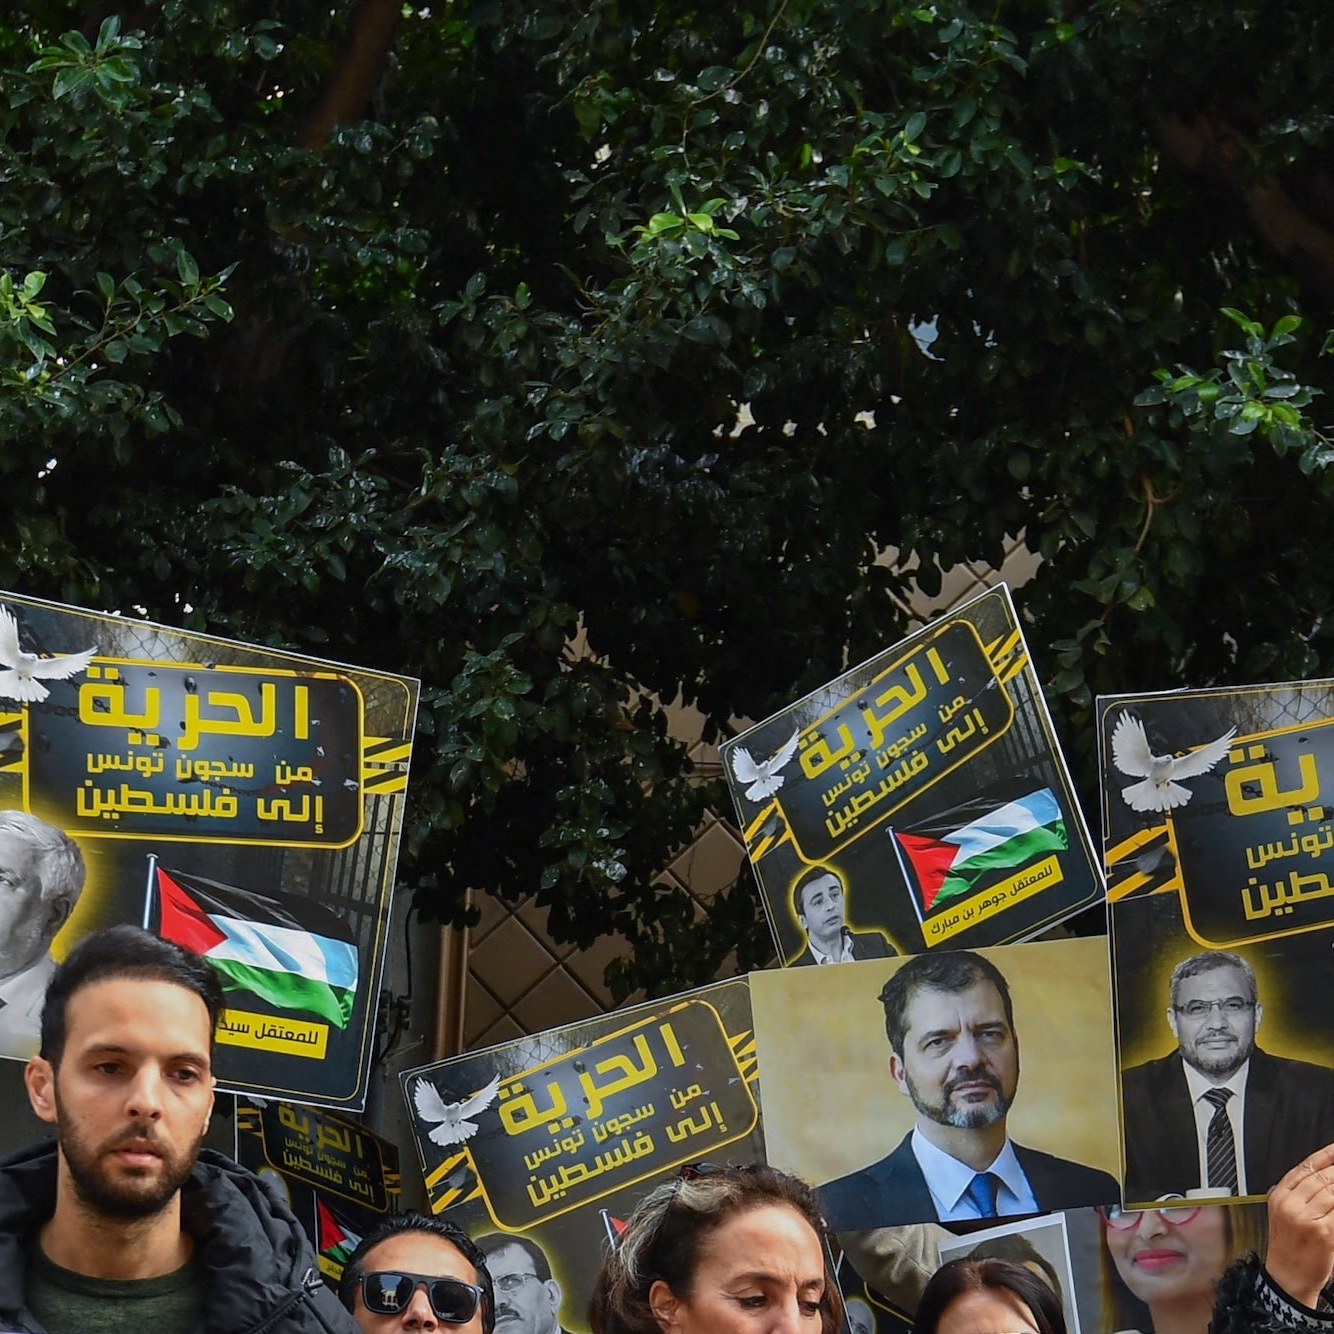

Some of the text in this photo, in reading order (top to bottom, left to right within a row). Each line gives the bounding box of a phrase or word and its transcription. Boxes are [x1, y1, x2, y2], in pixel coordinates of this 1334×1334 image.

[78, 666, 310, 751] الحرية
[798, 646, 950, 780] الحرية
[86, 750, 314, 786] من سجون تونس
[821, 694, 968, 807] من سجون تونس
[824, 708, 988, 839] إلى فلسطين
[76, 779, 324, 835] إلى فلسطين
[1245, 824, 1334, 870] تونس
[930, 865, 1053, 934] للمعتقل جوهر بن مبارك
[254, 1023, 318, 1045] للمعتقل
[497, 1023, 686, 1136] الحرية
[278, 1102, 364, 1159] الحرية
[284, 1136, 314, 1156] تونس
[524, 1082, 703, 1171] من سجون تونس
[525, 1101, 728, 1208] إلى فلسطين
[283, 1148, 343, 1185] فلسطين
